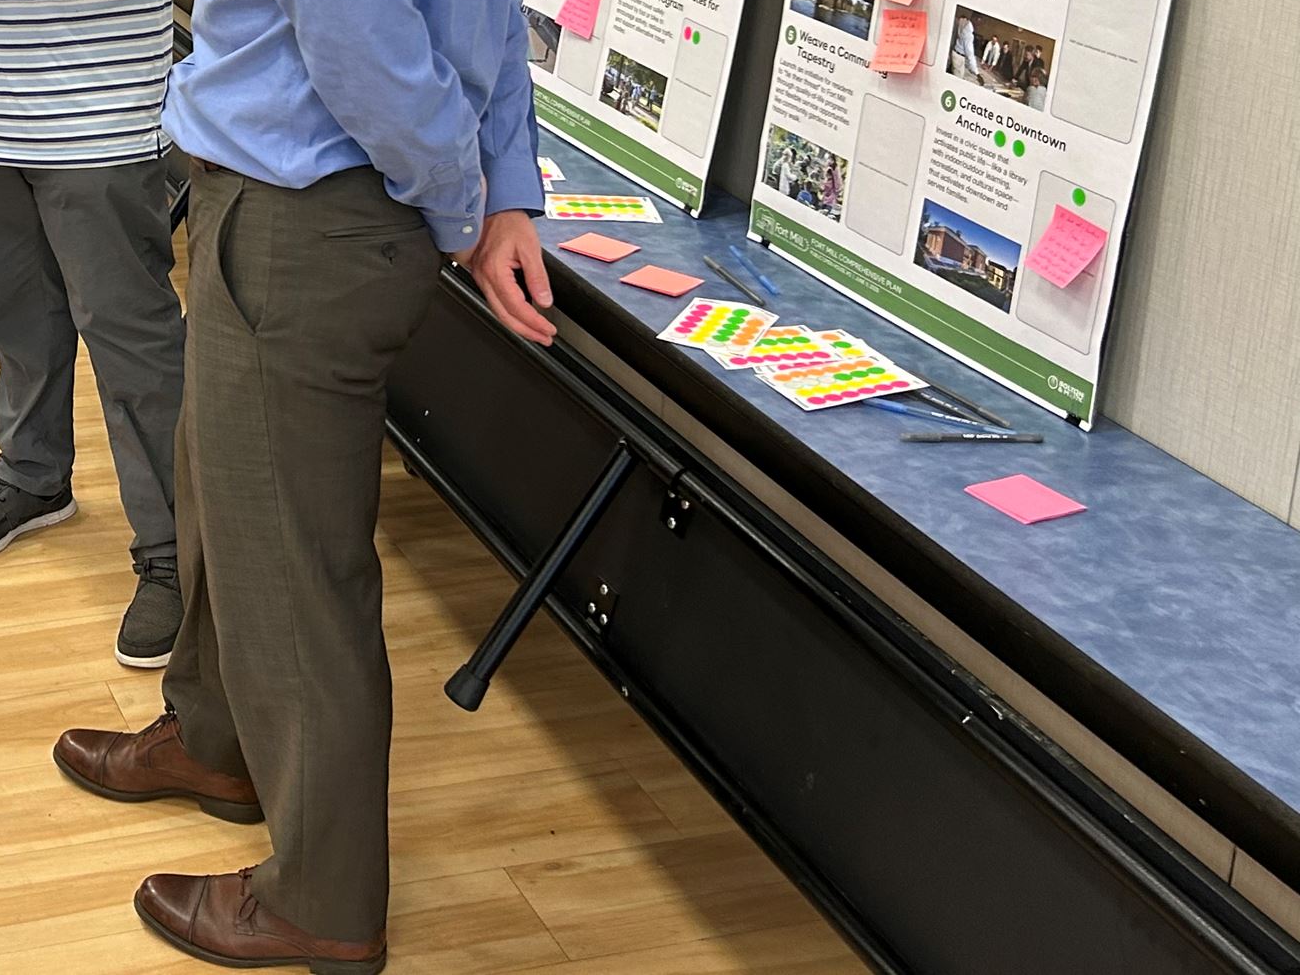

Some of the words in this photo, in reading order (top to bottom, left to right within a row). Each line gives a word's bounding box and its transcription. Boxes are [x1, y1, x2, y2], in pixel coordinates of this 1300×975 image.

[800, 29, 828, 50] Weave
[797, 46, 836, 73] Tapestry
[955, 115, 993, 138] Anchor
[959, 97, 994, 121] Create
[996, 115, 1003, 124] a
[1006, 117, 1067, 152] Downtown
[775, 223, 788, 238] Fort
[790, 230, 804, 247] Mill
[811, 238, 824, 250] FORT
[826, 246, 838, 258] MILL
[839, 253, 886, 285] COMPREHENSIVE
[886, 280, 902, 294] PLAN
[1059, 381, 1084, 398] BOLTON
